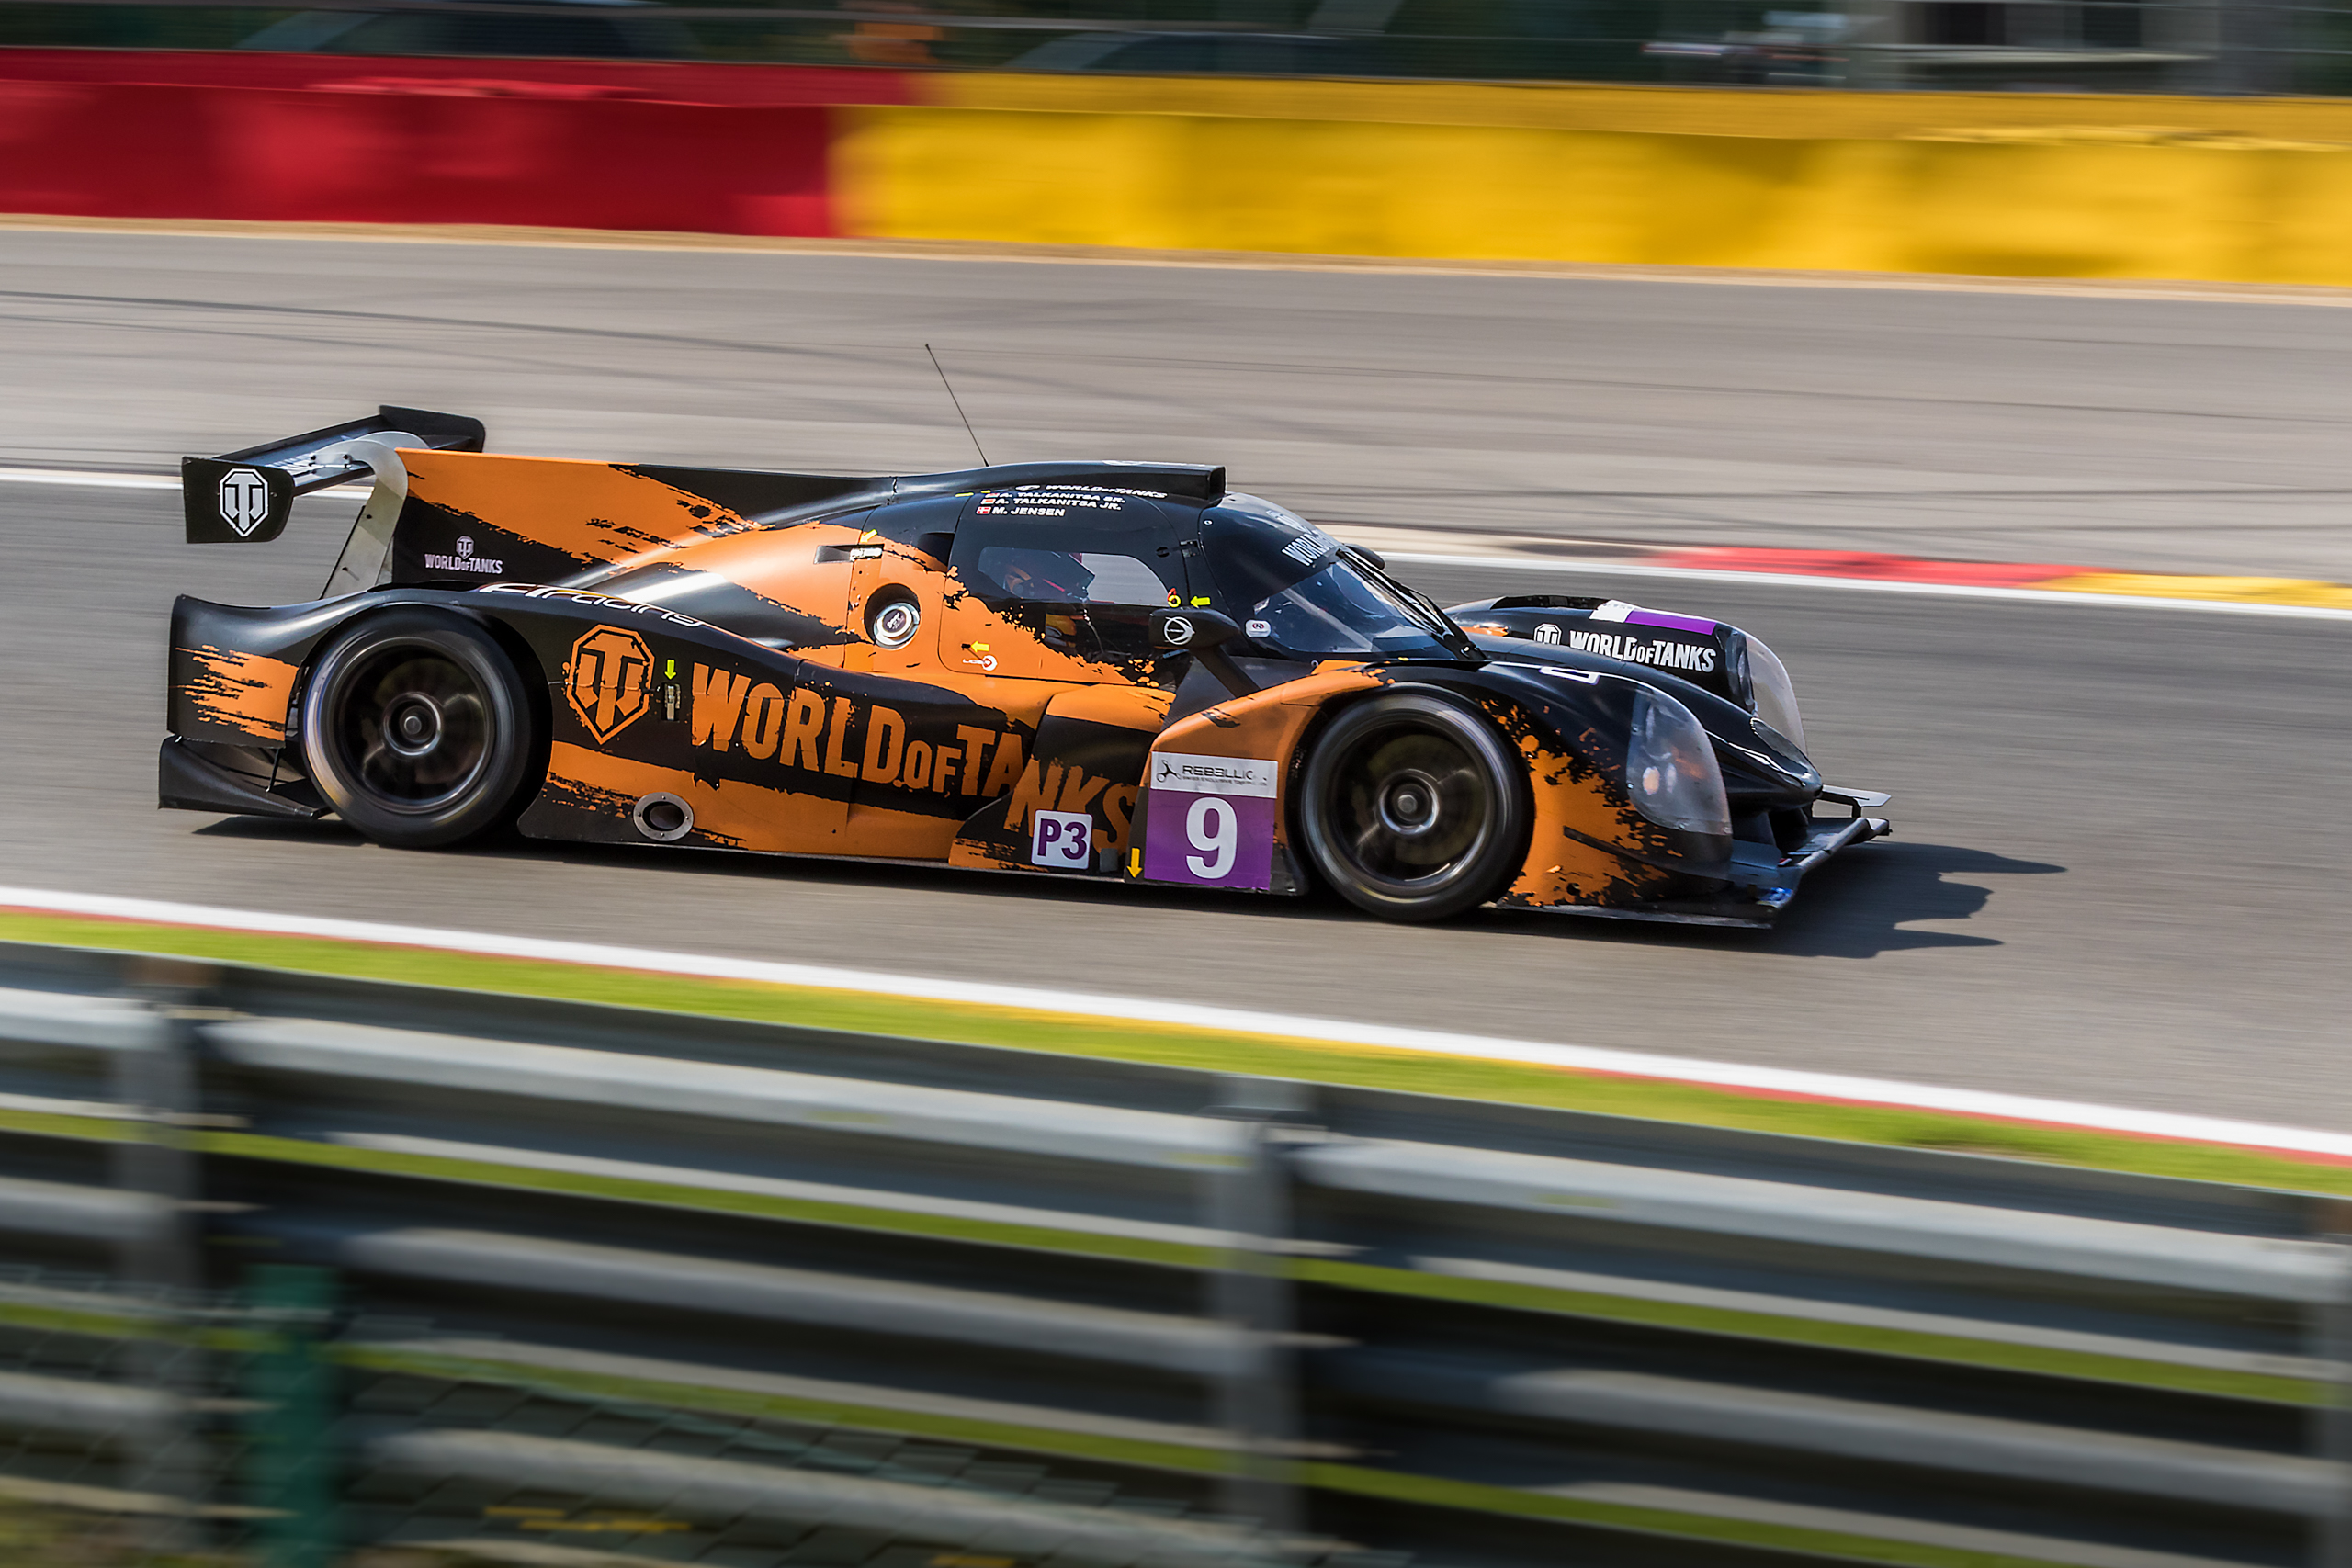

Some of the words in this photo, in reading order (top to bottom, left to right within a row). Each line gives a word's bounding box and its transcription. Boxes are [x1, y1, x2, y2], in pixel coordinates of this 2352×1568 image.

[1017, 492, 1101, 501] TALKANITSA
[1013, 498, 1097, 508] TALKANITSA
[992, 506, 1008, 514] M.
[1011, 507, 1065, 516] JENSEN
[1037, 818, 1088, 860] P3
[1186, 796, 1238, 880] 9
